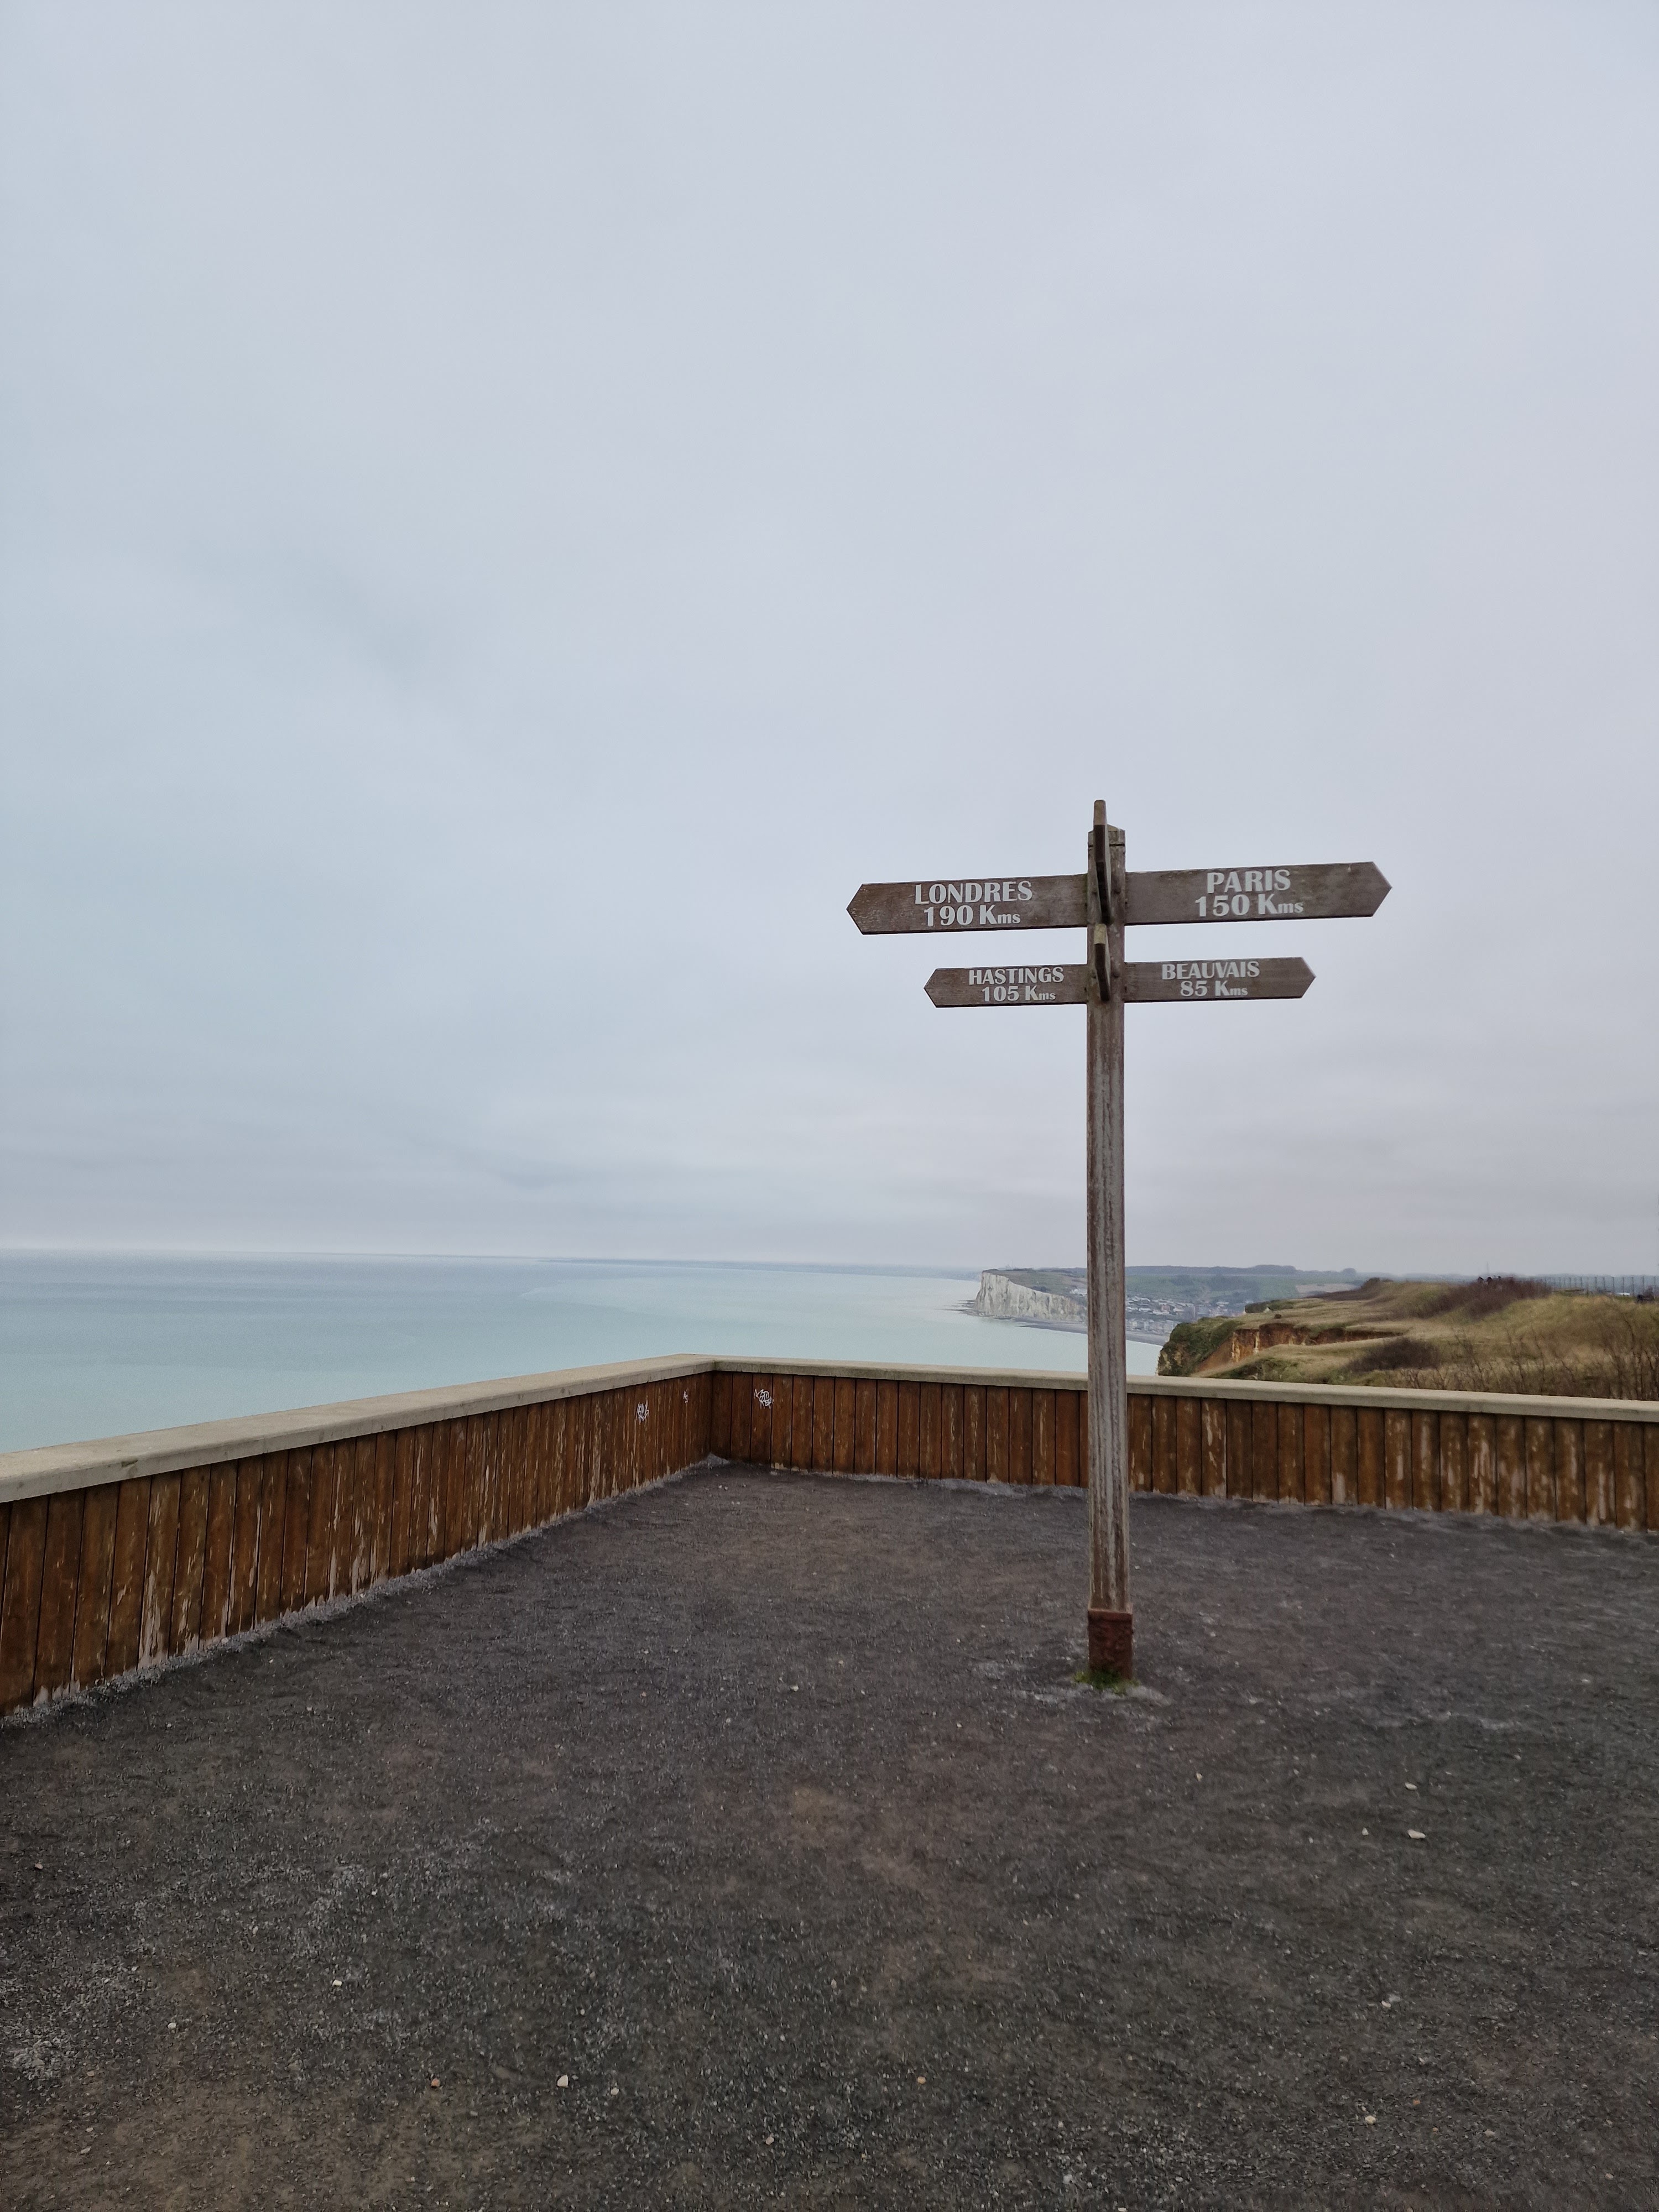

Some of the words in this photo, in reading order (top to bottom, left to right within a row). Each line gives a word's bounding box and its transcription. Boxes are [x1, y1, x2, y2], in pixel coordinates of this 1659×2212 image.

[1207, 869, 1291, 894] PARIS
[914, 880, 1033, 904] LONDRES
[924, 906, 973, 926] 190
[979, 904, 1021, 925] Kms
[1195, 895, 1250, 917] 150
[1258, 893, 1304, 915] Kms
[968, 967, 1065, 985] HASTINGS
[1161, 961, 1260, 980] BEAUVAIS
[982, 986, 1020, 1002] 105
[1025, 985, 1056, 1001] Kms
[1180, 980, 1208, 997] 85
[1214, 980, 1249, 997] Kms
